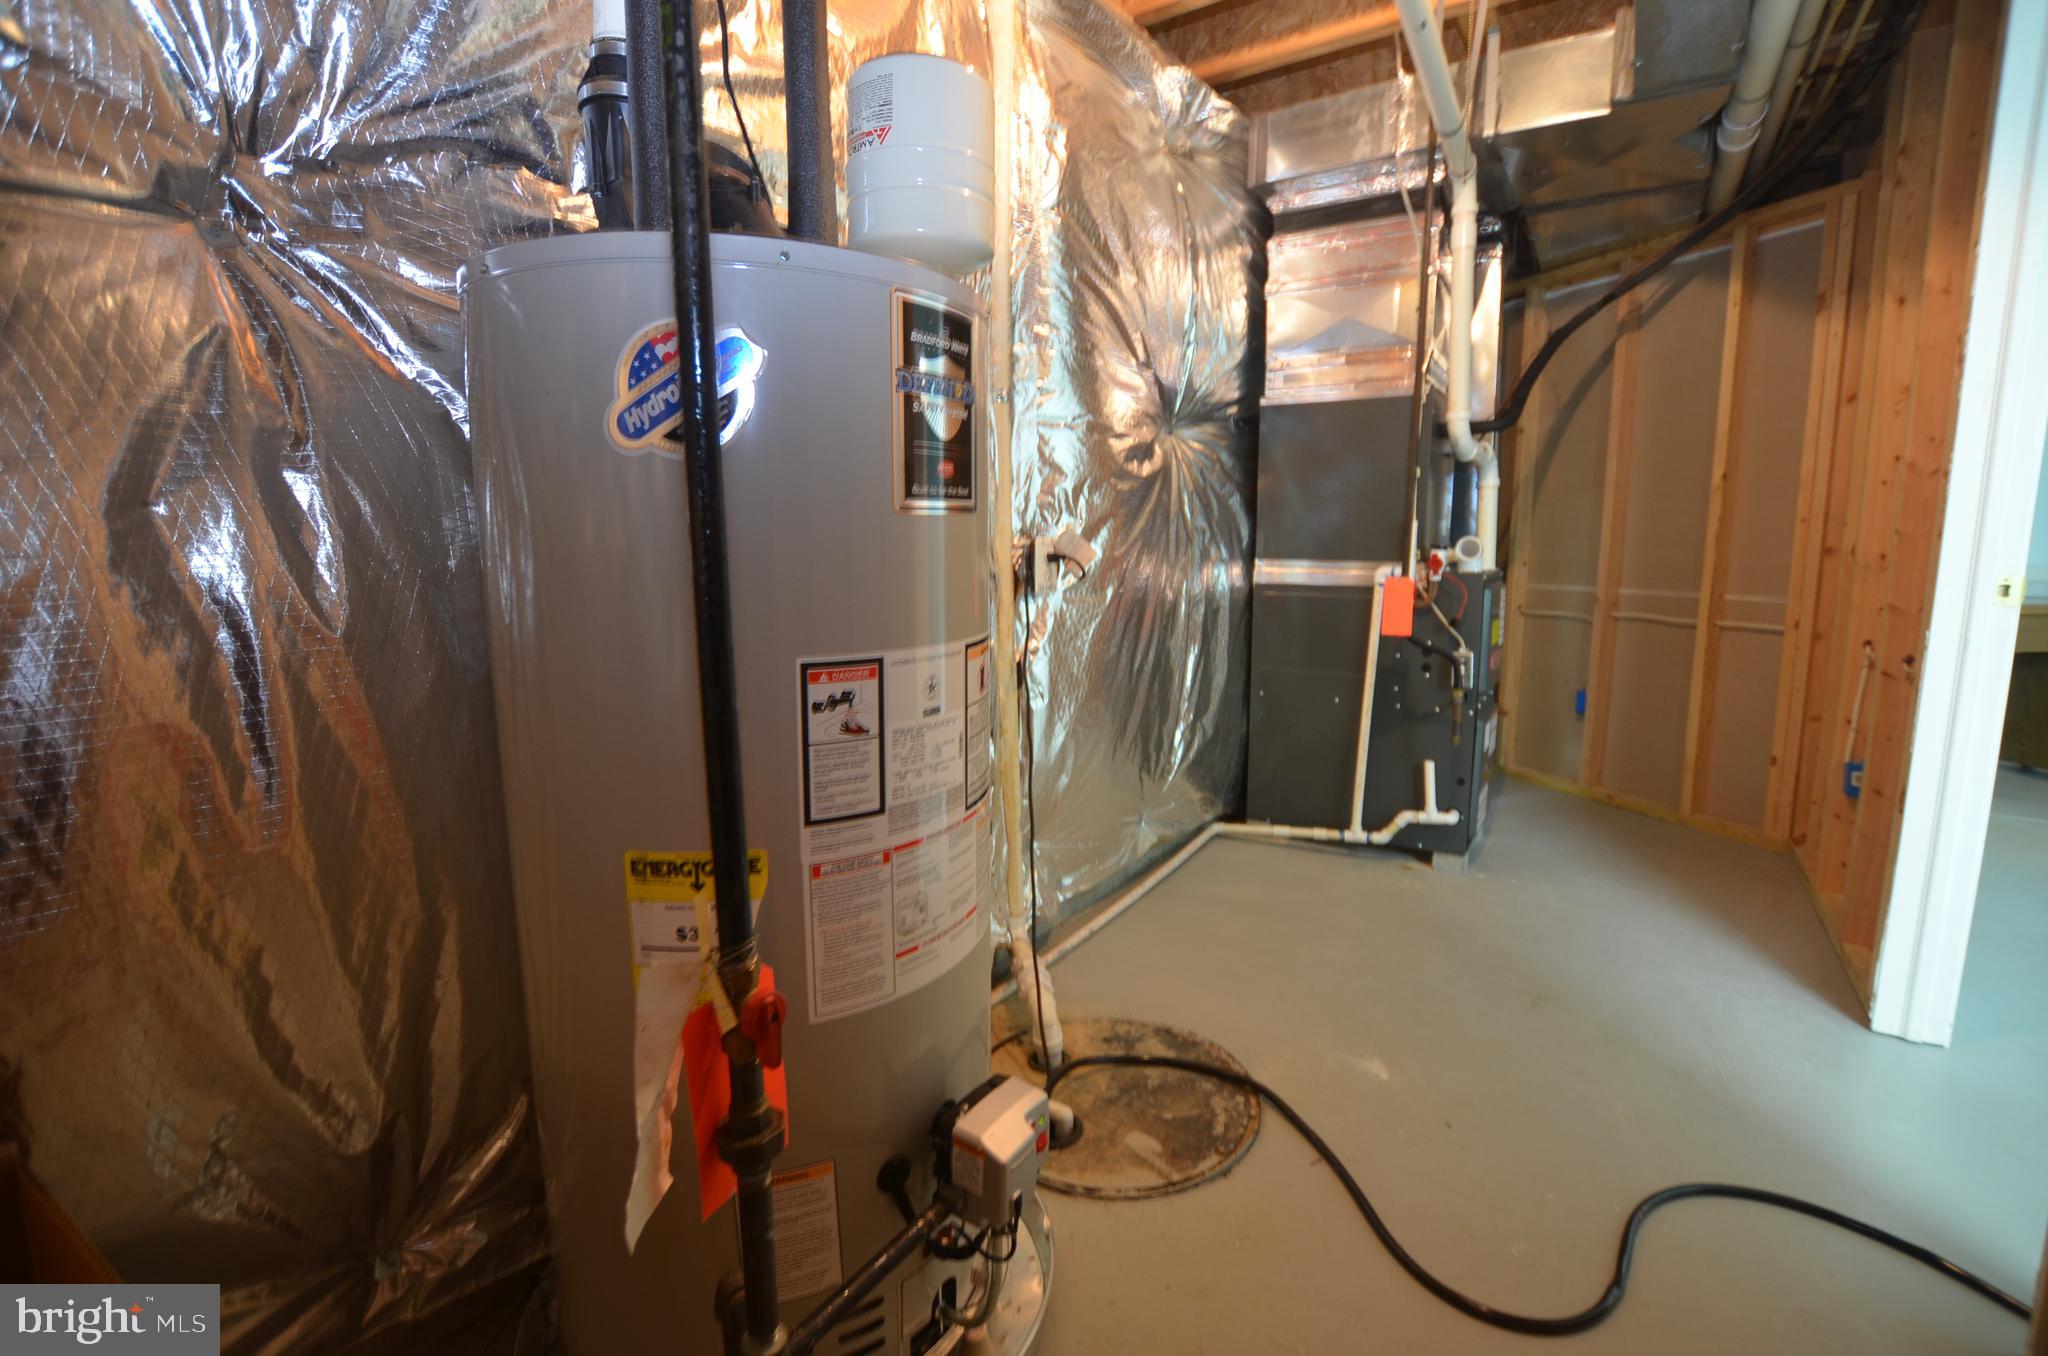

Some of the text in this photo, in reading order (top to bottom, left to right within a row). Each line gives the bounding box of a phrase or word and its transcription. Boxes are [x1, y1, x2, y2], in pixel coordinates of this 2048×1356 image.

[848, 136, 875, 156] AMTRO
[911, 331, 951, 350] BRADFORD
[623, 376, 681, 433] Hydro
[831, 668, 869, 681] DANGER
[630, 858, 761, 880] ENERGYGE
